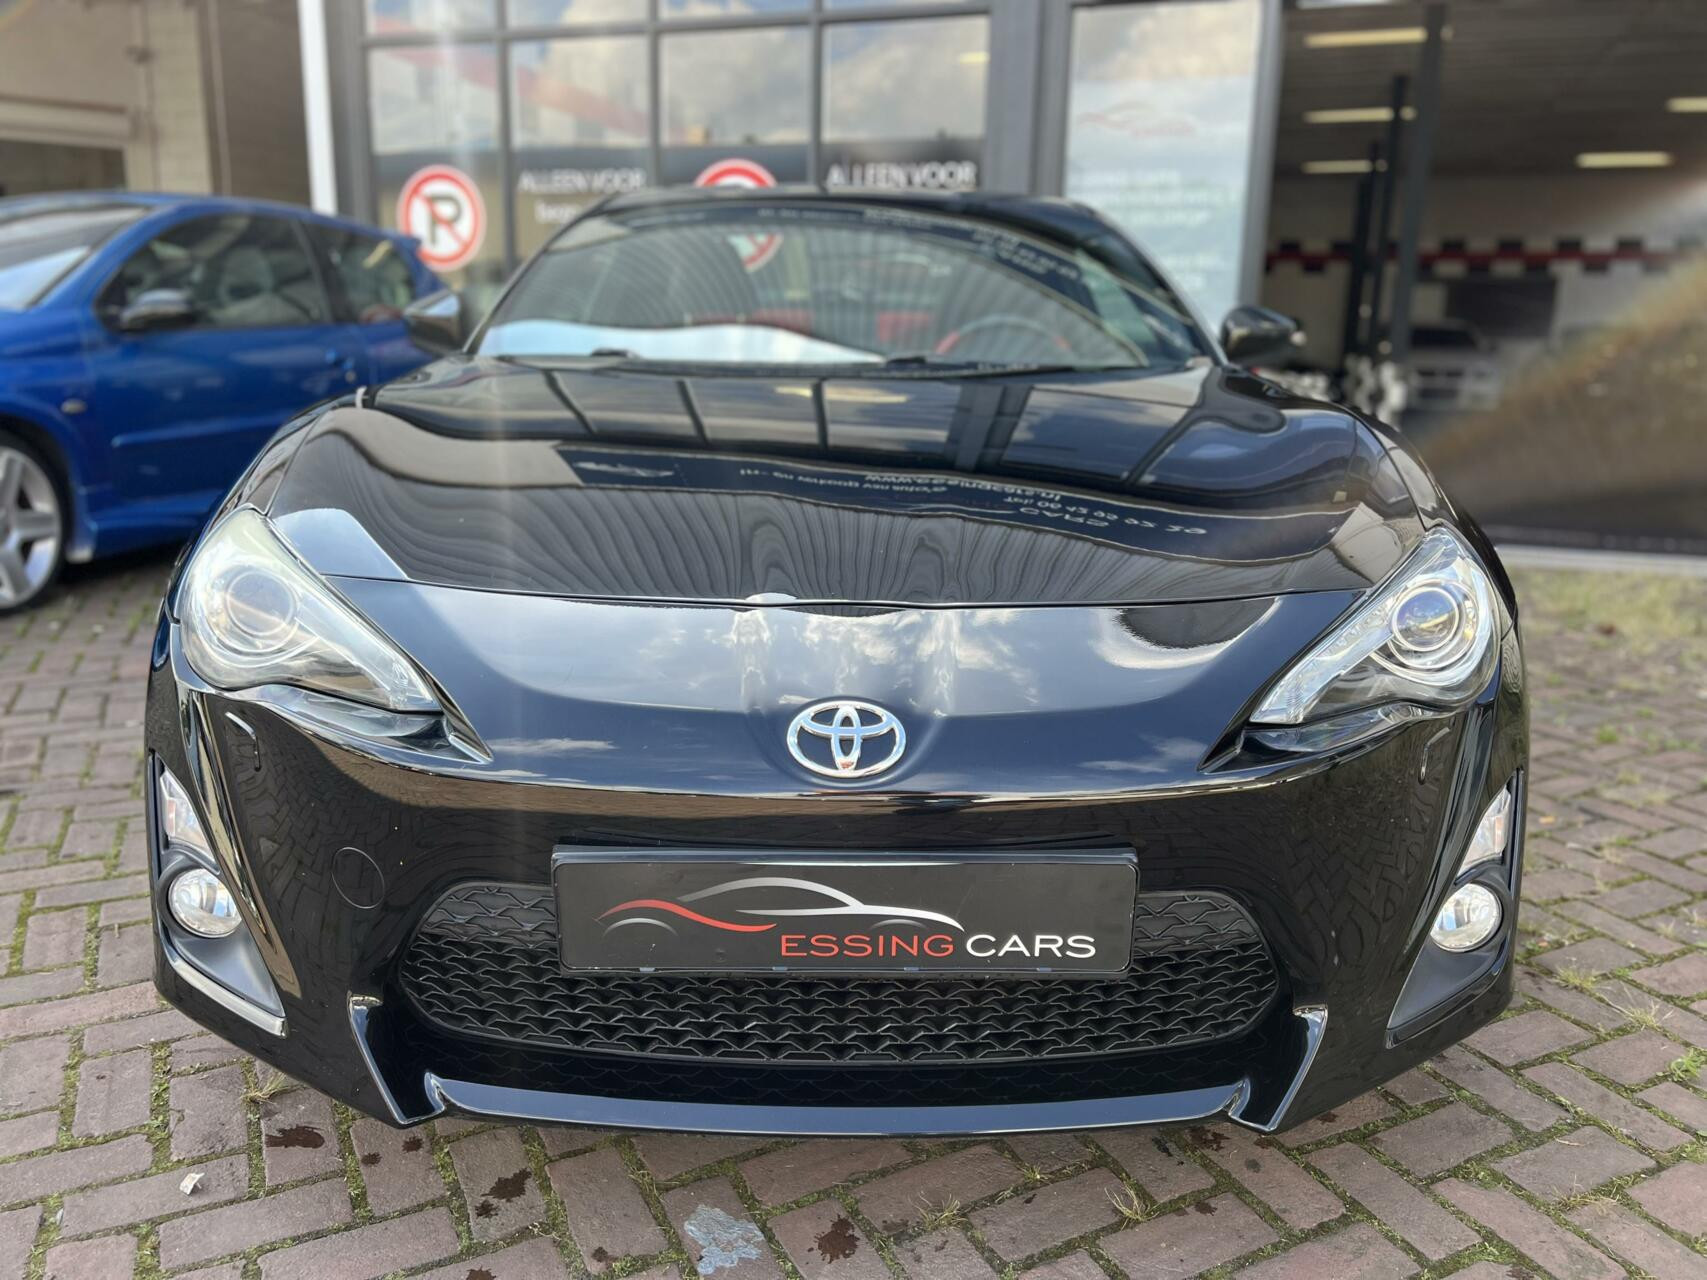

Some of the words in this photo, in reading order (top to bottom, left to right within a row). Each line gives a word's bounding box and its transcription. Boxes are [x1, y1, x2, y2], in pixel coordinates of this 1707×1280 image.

[907, 160, 977, 190] VOOR
[780, 934, 954, 958] ESSING
[965, 934, 1097, 959] CARS
